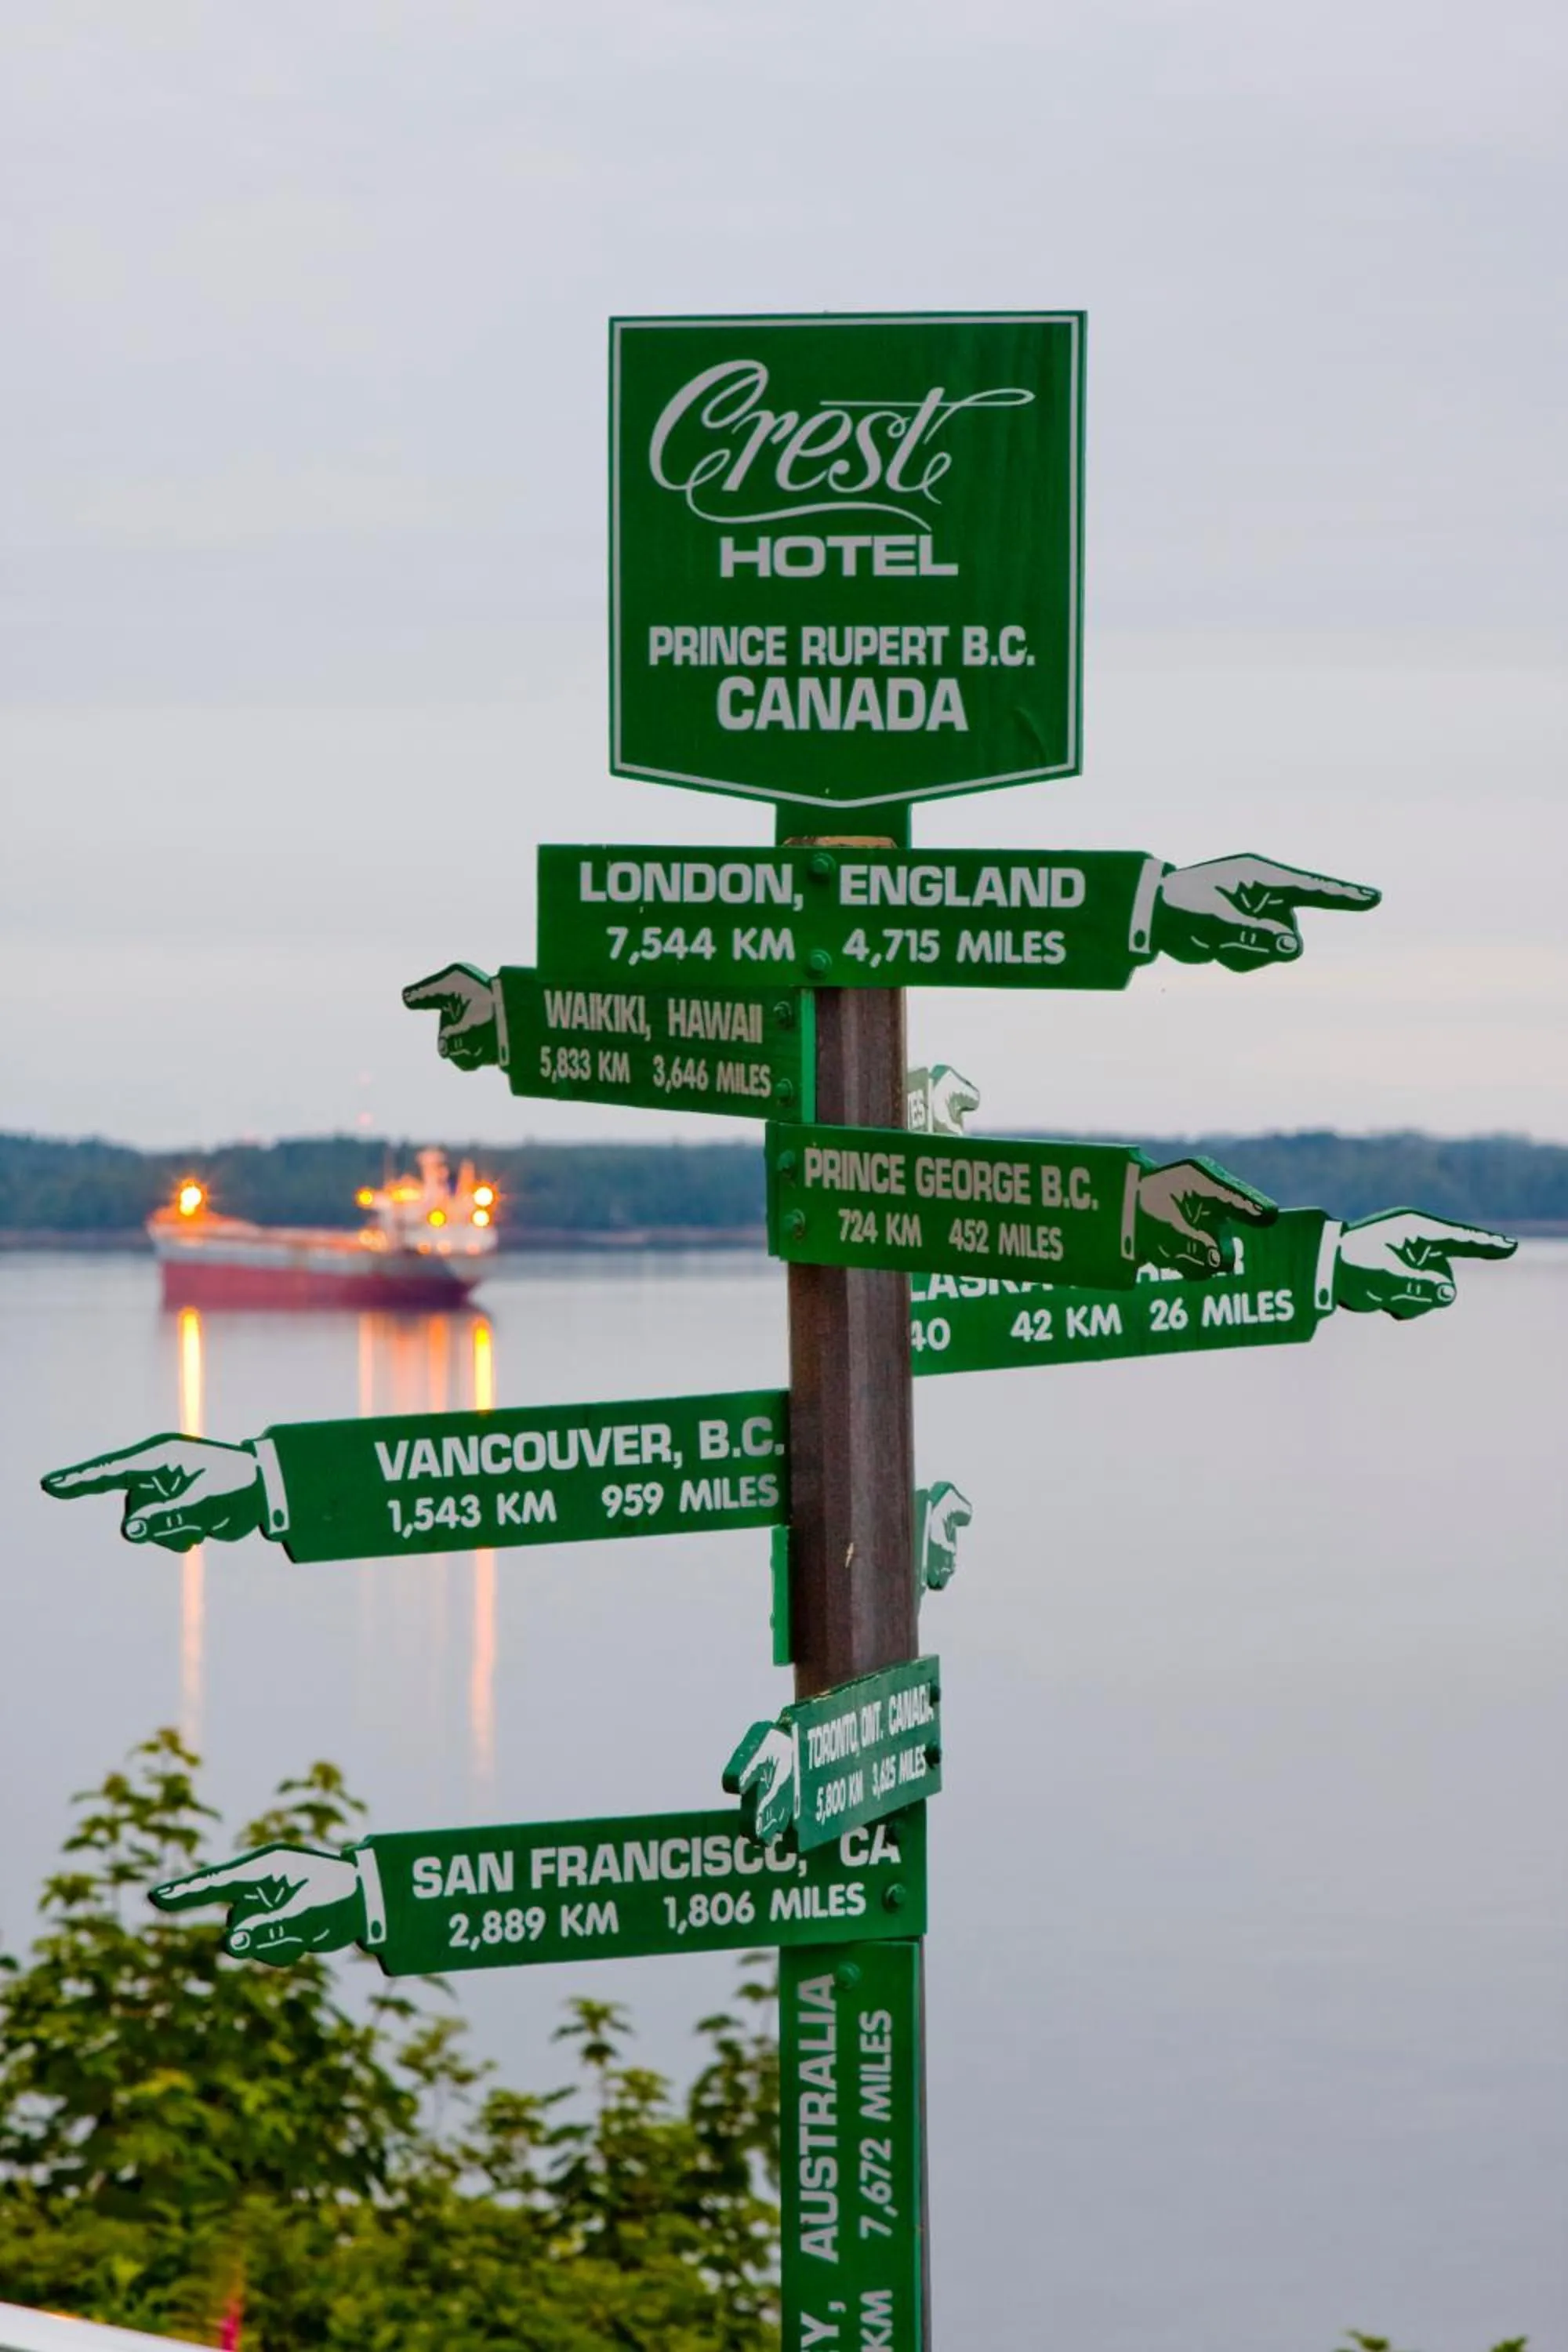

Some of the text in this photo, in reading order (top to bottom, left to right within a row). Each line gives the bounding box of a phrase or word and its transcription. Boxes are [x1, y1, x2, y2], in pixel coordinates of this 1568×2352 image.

[648, 358, 1035, 533] Crest
[720, 535, 958, 577] HOTEL
[649, 626, 1035, 666] PRINCE RUPERT B.C.
[717, 677, 969, 732] CANADA
[579, 861, 1086, 912] LONDON, ENGLAND
[606, 927, 1066, 968] 7,544 KM 4,715 MILES
[544, 989, 763, 1044] WAIKIKI, HAWAII
[540, 1046, 771, 1098] 5,833 KM 3,646 MILES
[804, 1148, 1099, 1211] PRINCE GEORGE B.C.
[838, 1208, 1064, 1262] 724 KM 452 MILES
[1011, 1310, 1054, 1342] 42
[1065, 1303, 1123, 1338] KM
[1149, 1298, 1189, 1332] 26
[1201, 1289, 1295, 1327] MILES
[375, 1417, 786, 1482] VANCOUVER, B.C.
[387, 1474, 779, 1538] 1,543 KM 959 MILES
[808, 1682, 935, 1769] TORONTO, ONT. CANADA
[848, 1769, 863, 1809] KM
[898, 1744, 927, 1785] MILES
[412, 1824, 902, 1899] SAN FRANCISCO, CA
[448, 1882, 866, 1951] 2,889 KM 1,806 MILES
[797, 1973, 840, 2264] AUSTRALIA
[859, 2009, 898, 2352] KM 7,672 MILES
